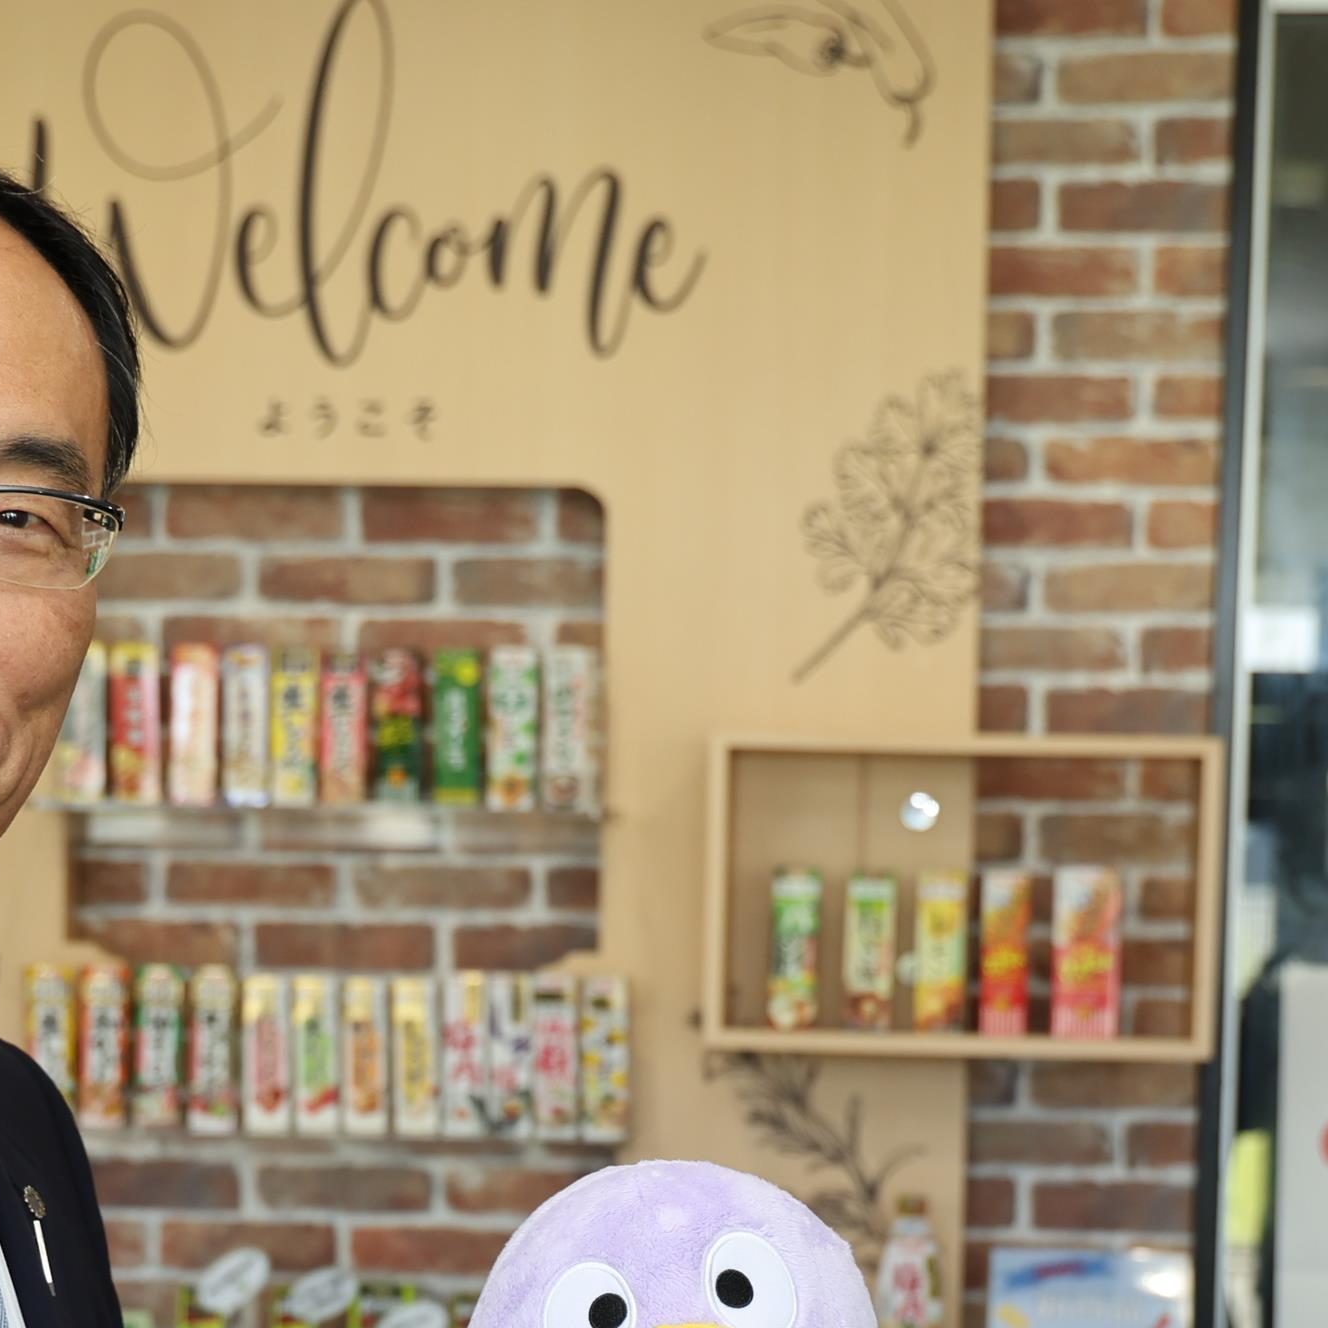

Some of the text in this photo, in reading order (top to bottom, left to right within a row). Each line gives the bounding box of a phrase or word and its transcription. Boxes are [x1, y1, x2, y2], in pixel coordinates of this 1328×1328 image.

[31, 0, 708, 367] Welcome
[255, 395, 440, 442] ようこそ
